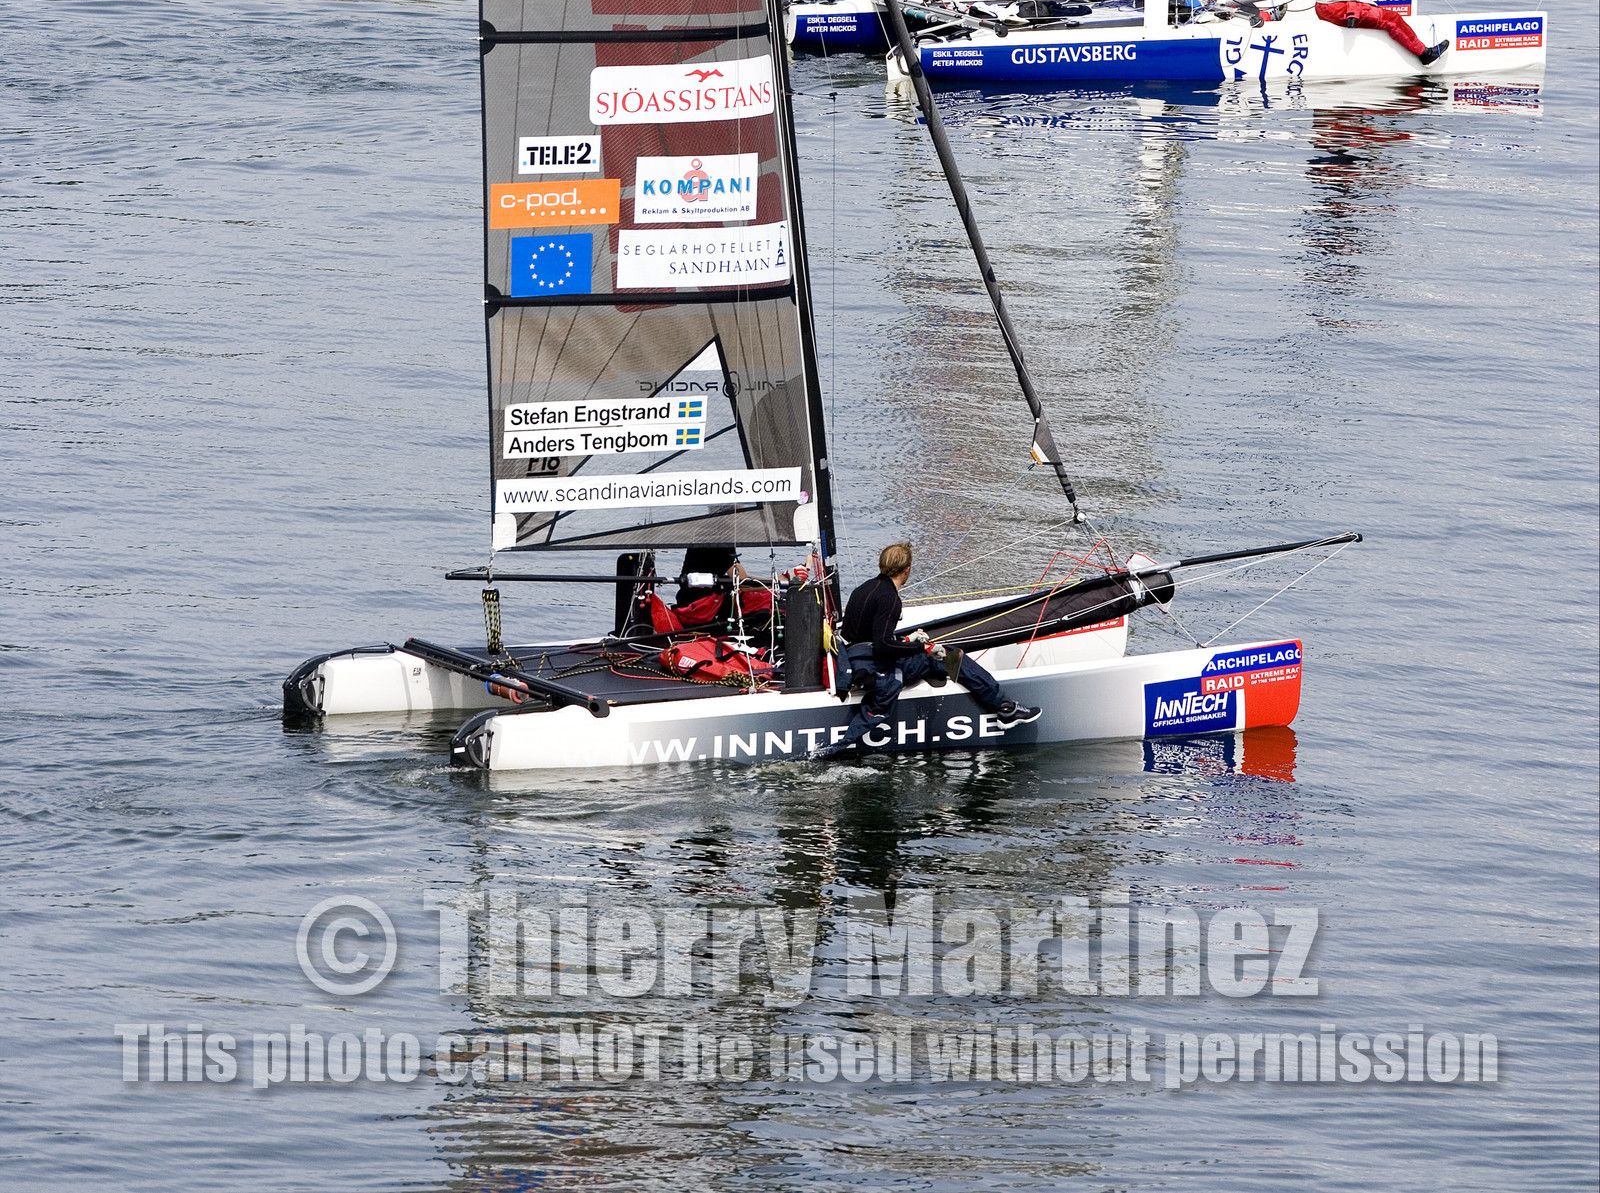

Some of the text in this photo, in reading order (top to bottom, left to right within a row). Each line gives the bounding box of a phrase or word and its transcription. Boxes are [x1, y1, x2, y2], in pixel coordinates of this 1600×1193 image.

[806, 16, 857, 25] ESKIL DEGSELL
[1460, 21, 1539, 33] ARCHIPELAGO
[806, 24, 857, 33] PETER MICKOS
[1459, 39, 1490, 49] RAID
[932, 50, 983, 58] ESKIL DEGSELL
[1011, 44, 1137, 64] GUSTAVSBERG
[932, 59, 983, 68] PETER MICKOS
[596, 81, 771, 118] SJÖASSISTANS
[643, 176, 751, 196] KOMPANI
[681, 207, 738, 215] Skyltproduktion
[623, 239, 771, 256] SEGLARHOTELLET
[669, 258, 770, 275] SANDHAMN
[510, 401, 670, 427] Stefan Engstrand
[508, 430, 668, 454] Anders Tengbom
[503, 477, 792, 504] www.scandinavianislands.com
[1251, 668, 1284, 680] EXTREME
[1206, 676, 1244, 691] RAID
[1153, 711, 1227, 727] OFFICIAL SIGNMAKER
